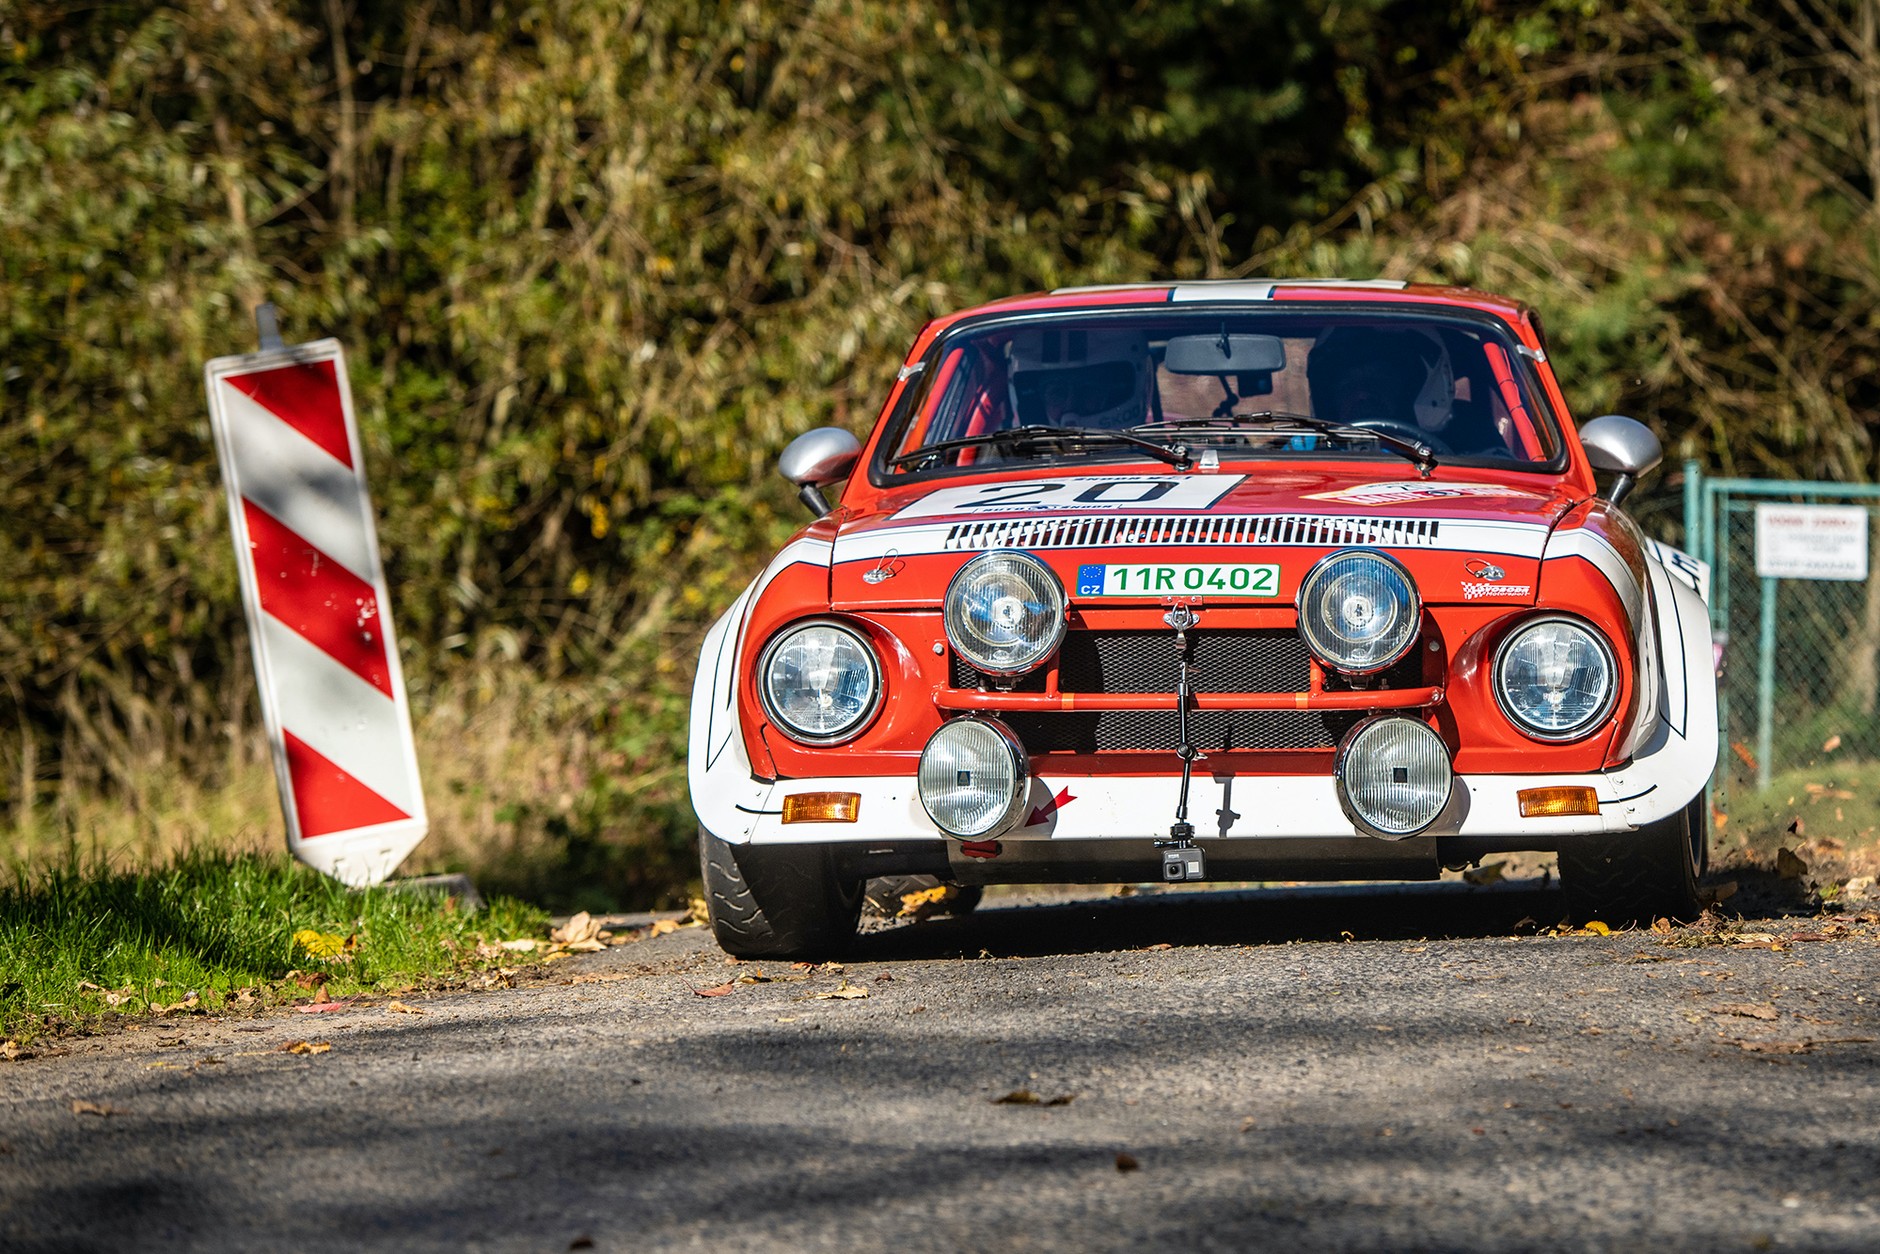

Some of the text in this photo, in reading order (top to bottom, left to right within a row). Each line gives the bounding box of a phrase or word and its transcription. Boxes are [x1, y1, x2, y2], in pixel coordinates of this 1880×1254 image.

[954, 481, 1180, 508] 20
[1080, 584, 1101, 595] CZ
[1113, 567, 1273, 591] 11R 0402
